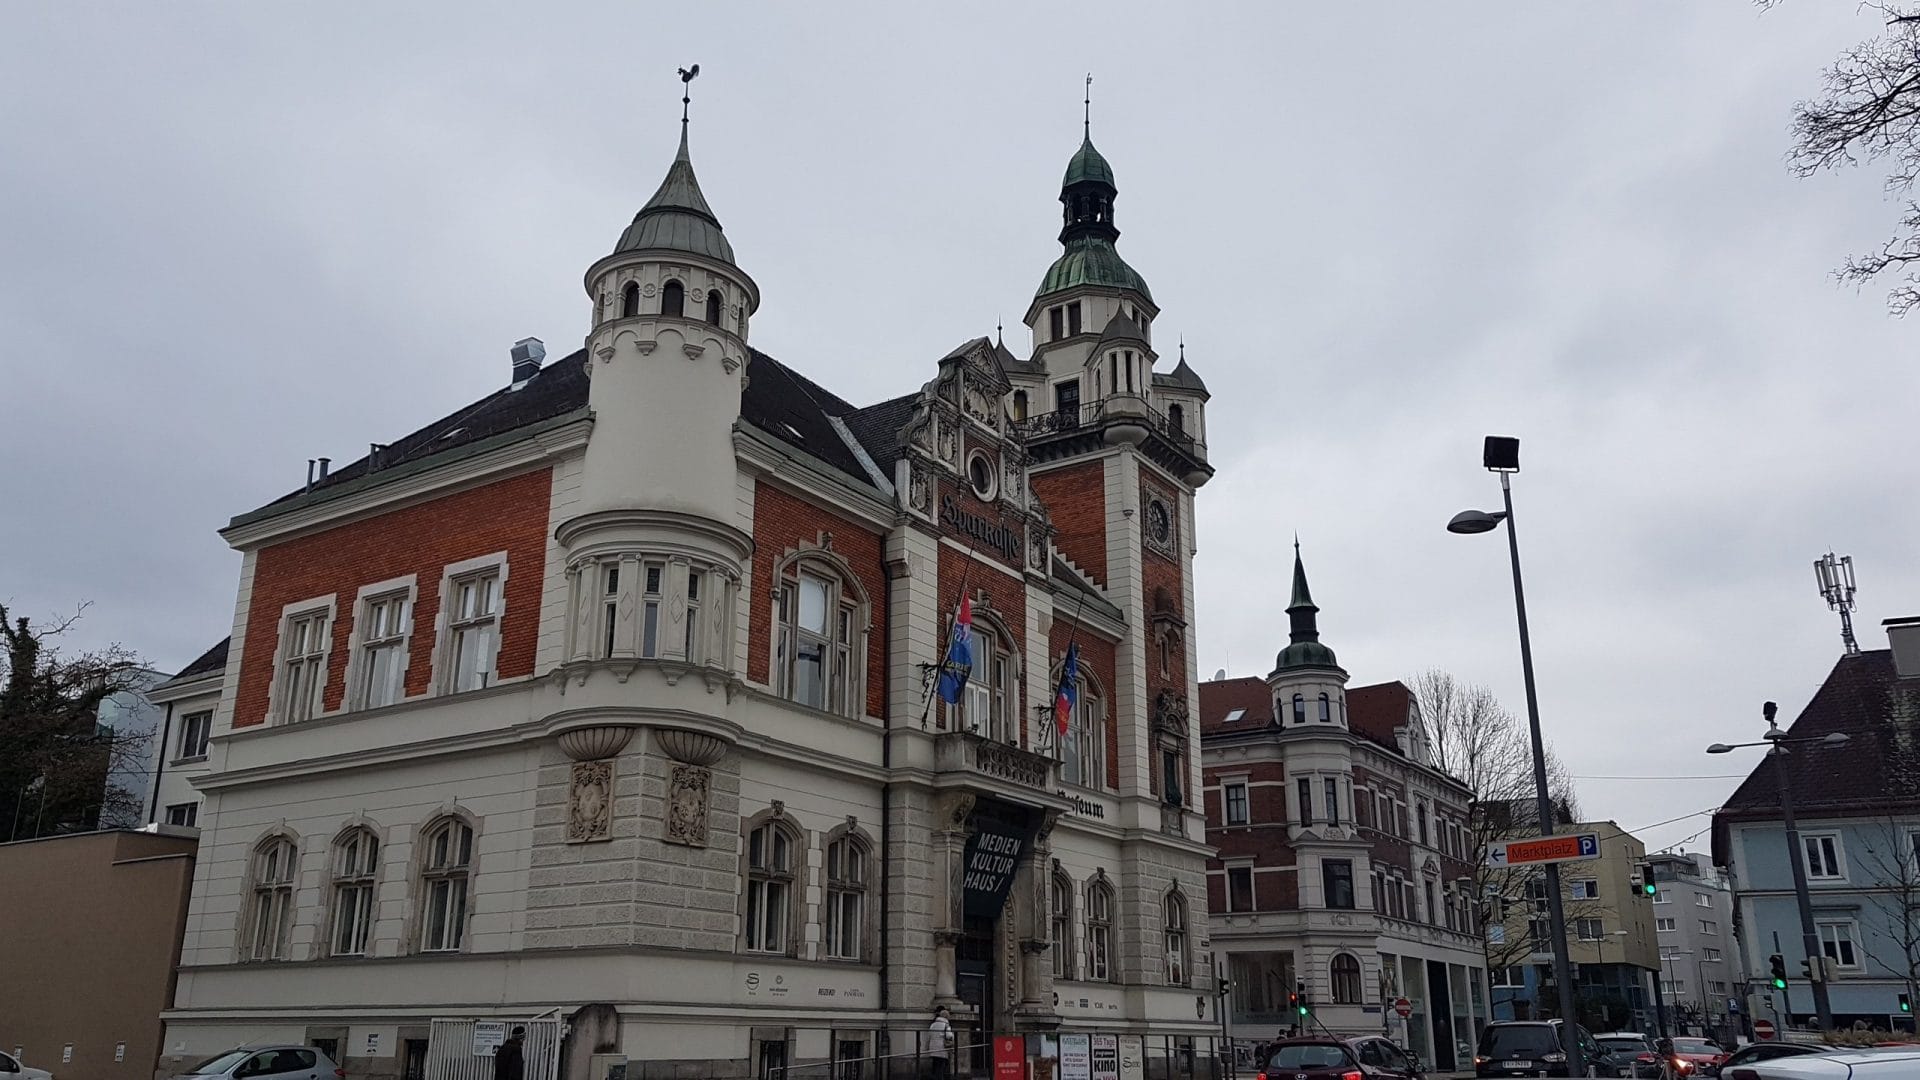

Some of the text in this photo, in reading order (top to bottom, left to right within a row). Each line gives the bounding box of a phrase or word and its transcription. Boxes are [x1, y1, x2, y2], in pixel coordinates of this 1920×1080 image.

[978, 833, 1021, 855] MEDIEN
[1512, 840, 1592, 859] Marktplatz P
[970, 853, 1013, 874] KULTUR
[1094, 1060, 1115, 1073] KINO
